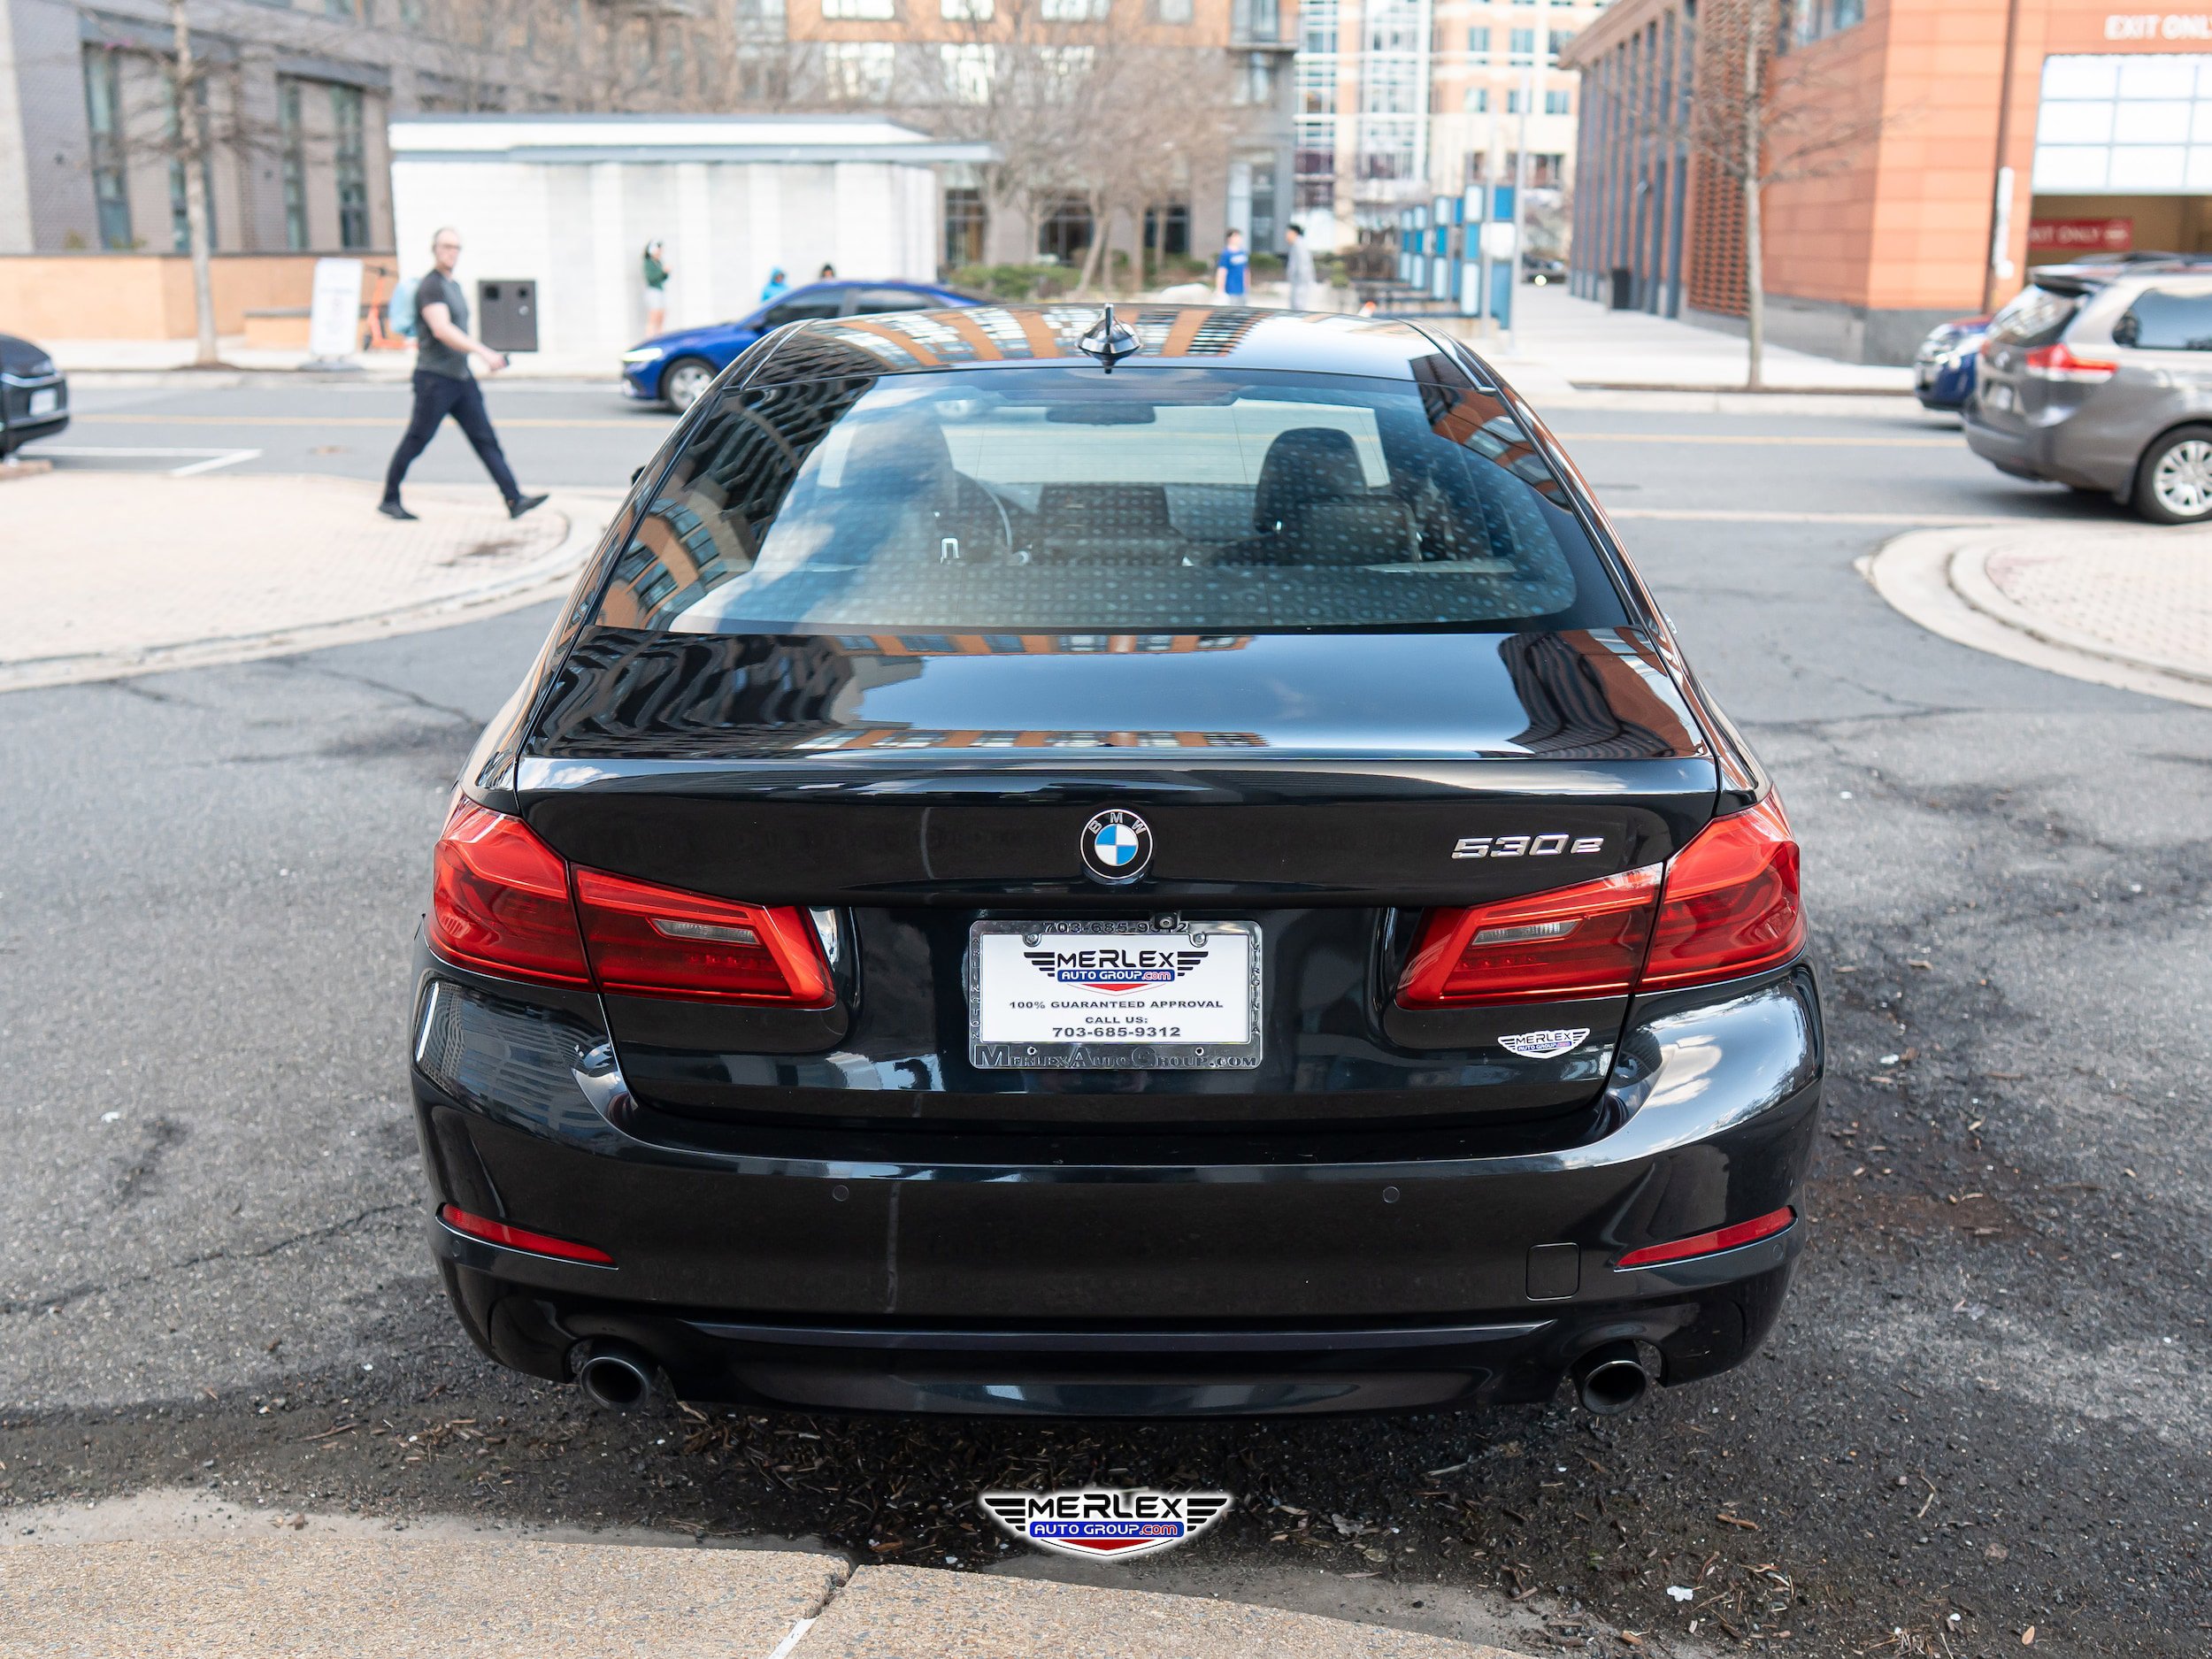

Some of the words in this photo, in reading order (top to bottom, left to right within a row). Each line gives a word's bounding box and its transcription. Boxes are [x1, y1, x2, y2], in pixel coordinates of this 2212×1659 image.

[2104, 13, 2160, 41] EXIT
[1088, 811, 1147, 834] BMW
[1451, 833, 1604, 859] 530e
[1056, 949, 1175, 968] MERLEX
[1061, 971, 1097, 980] AUTO
[1010, 1001, 1046, 1010] 100%
[1052, 1026, 1181, 1038] 703-685-9312
[1516, 1033, 1571, 1045] MERLEX
